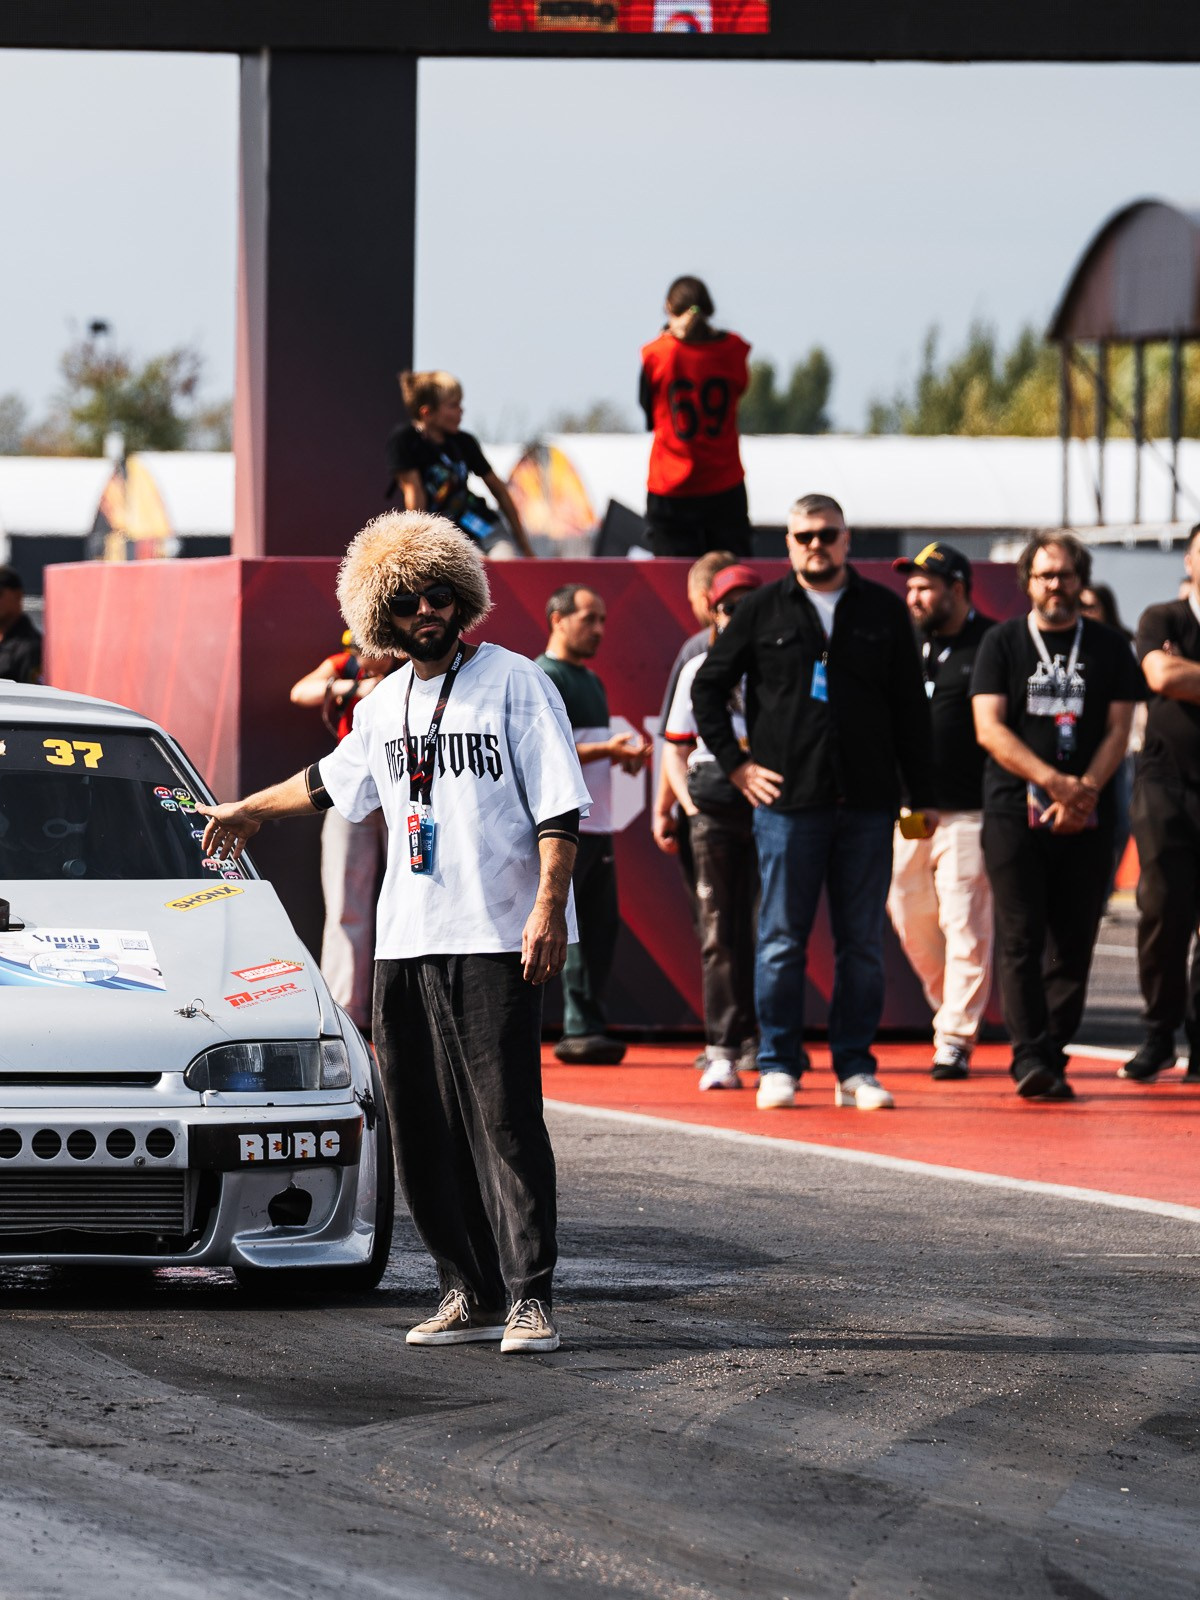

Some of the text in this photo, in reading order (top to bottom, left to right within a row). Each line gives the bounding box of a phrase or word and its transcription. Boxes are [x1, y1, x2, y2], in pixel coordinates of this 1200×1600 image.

[668, 377, 729, 440] 69
[42, 738, 103, 769] 37
[172, 886, 238, 909] SHONX
[251, 982, 298, 1000] PSR
